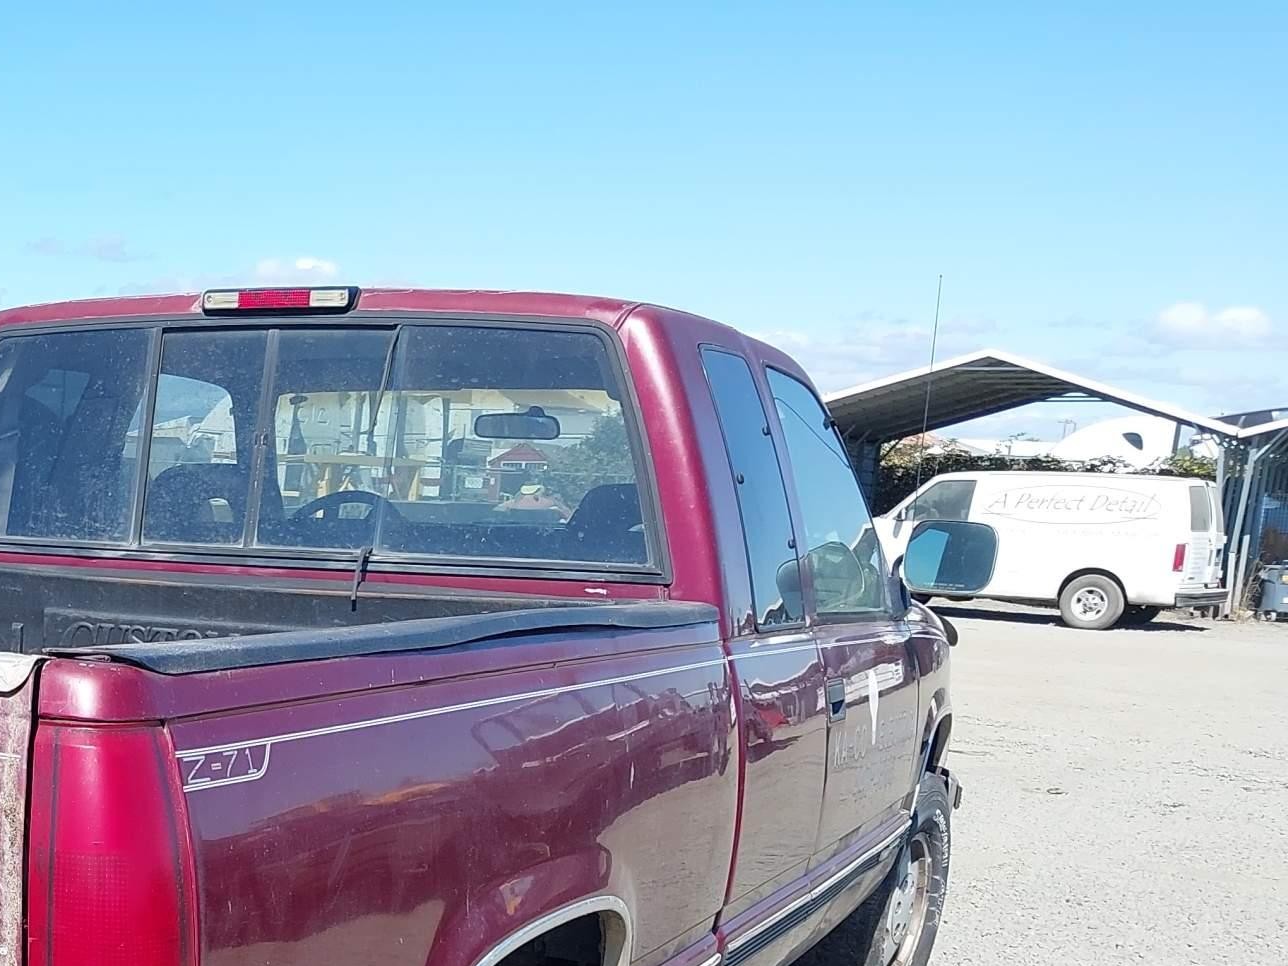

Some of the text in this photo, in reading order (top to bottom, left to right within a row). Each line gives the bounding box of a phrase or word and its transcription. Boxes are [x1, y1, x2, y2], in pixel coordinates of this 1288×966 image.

[988, 493, 1158, 514] A Perfect Detail
[182, 748, 258, 784] Z-71
